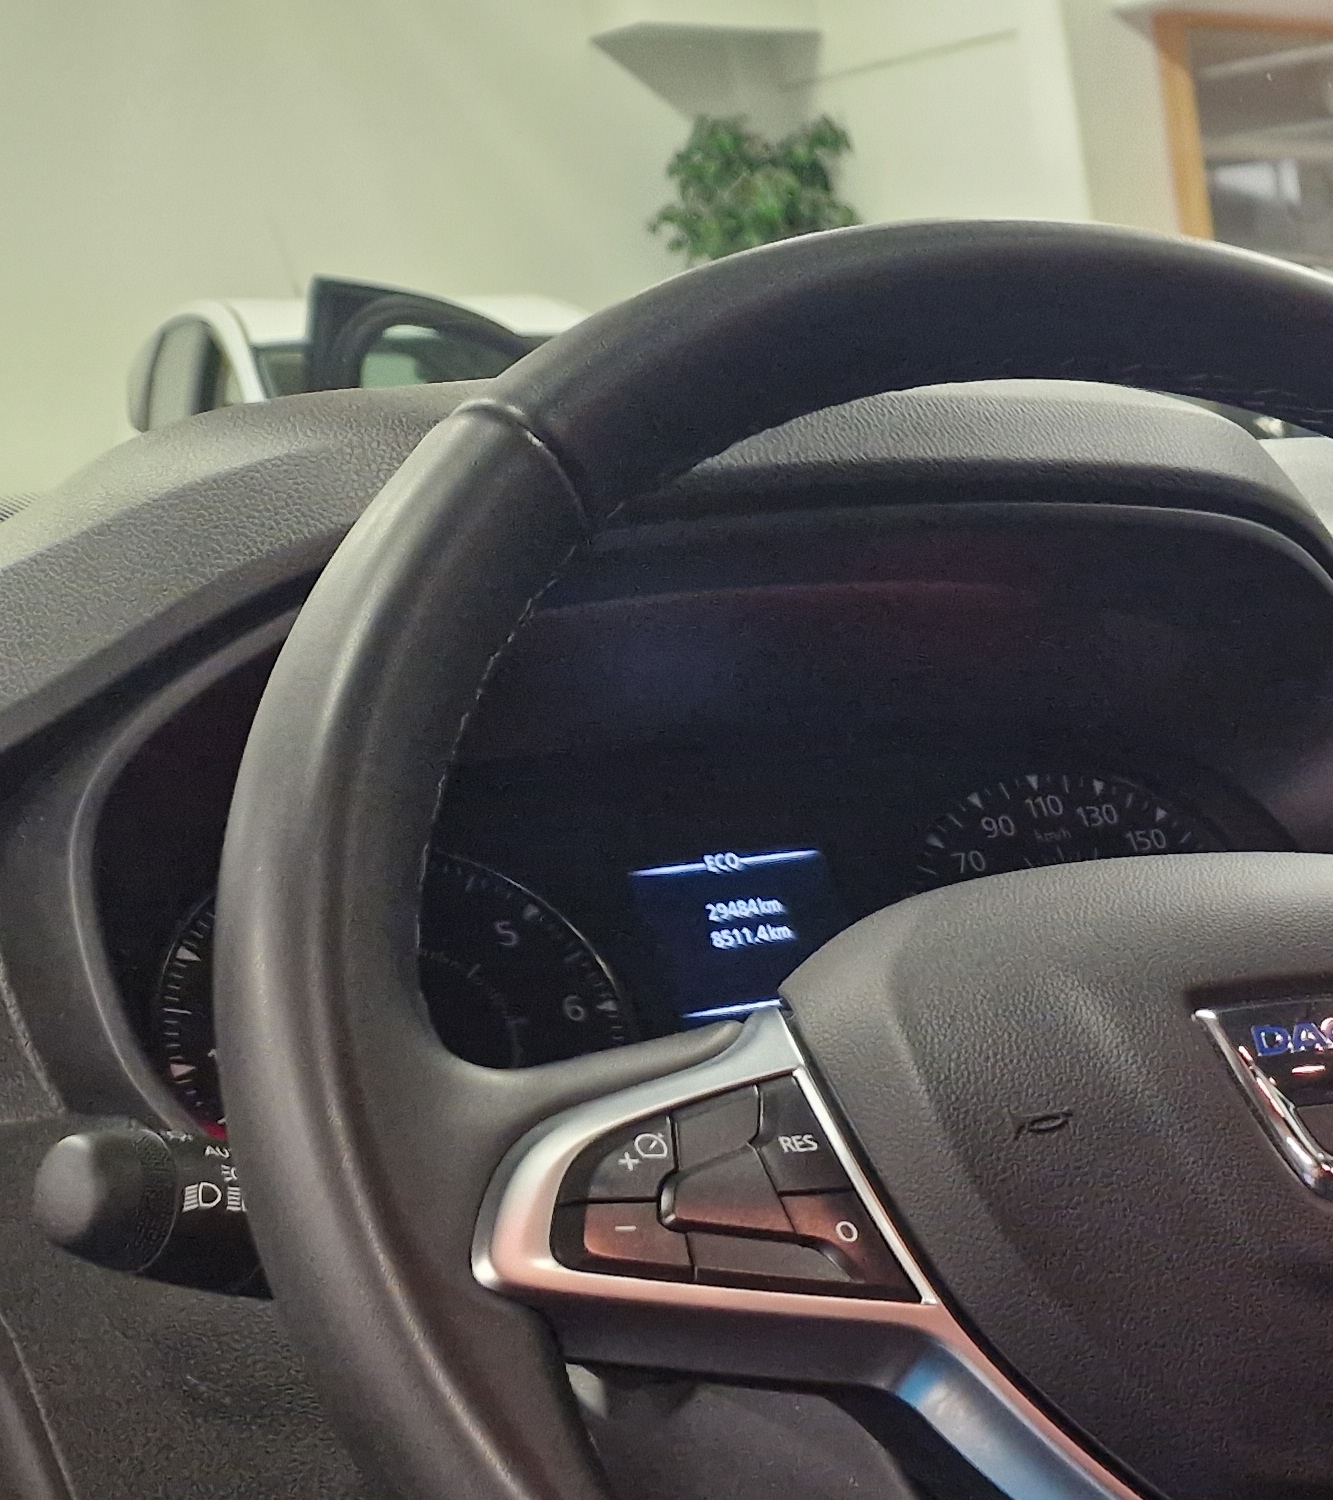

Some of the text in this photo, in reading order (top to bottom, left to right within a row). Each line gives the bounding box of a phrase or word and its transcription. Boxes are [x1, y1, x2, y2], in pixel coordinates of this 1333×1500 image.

[1025, 794, 1063, 818] 110
[1076, 803, 1119, 828] 130
[981, 815, 1015, 838] 90
[1126, 828, 1167, 852] 150
[703, 851, 744, 875] ECO
[952, 850, 986, 874] 70
[495, 921, 519, 946] 5
[563, 994, 586, 1021] 6
[778, 1133, 820, 1154] RES
